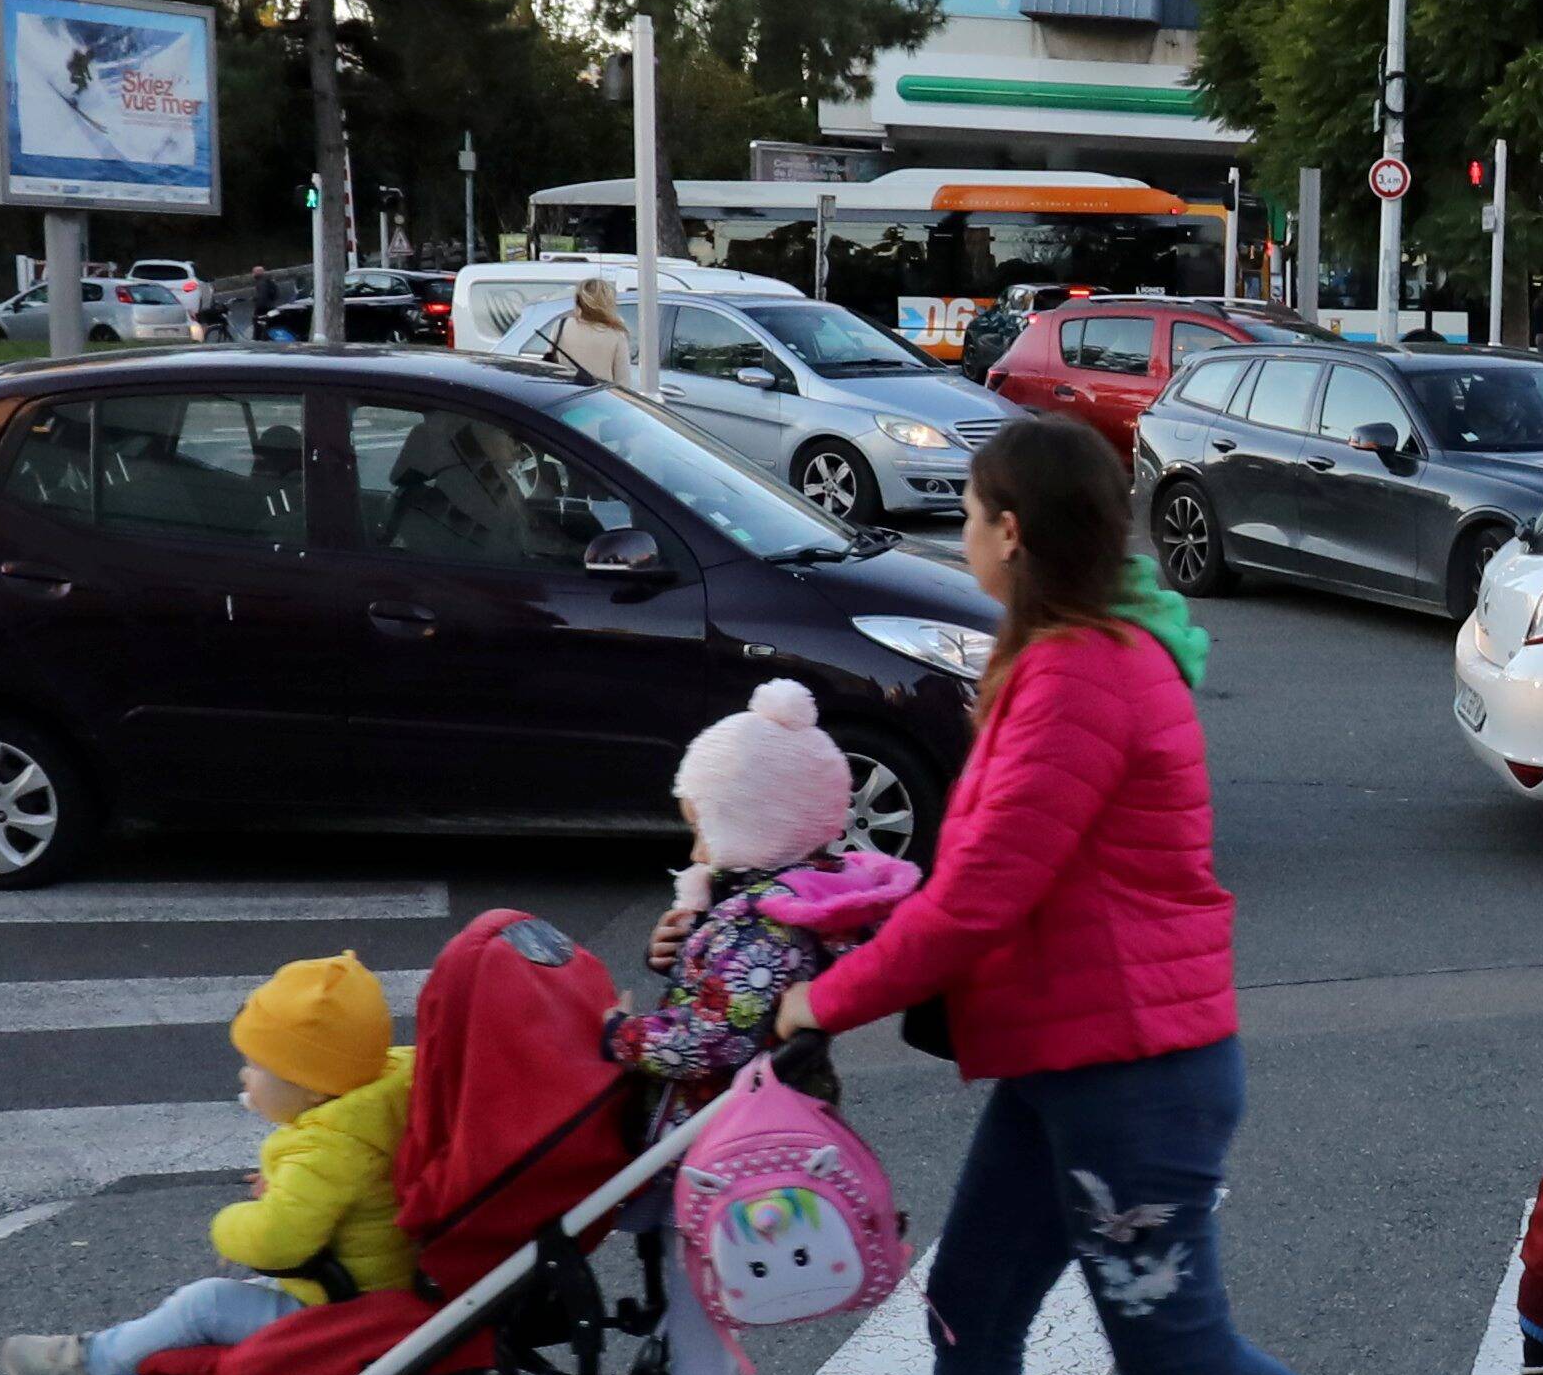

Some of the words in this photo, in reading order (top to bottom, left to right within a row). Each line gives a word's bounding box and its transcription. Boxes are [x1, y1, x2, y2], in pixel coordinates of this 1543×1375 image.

[121, 69, 174, 97] Skiez
[121, 93, 157, 112] vue
[161, 97, 202, 115] mer
